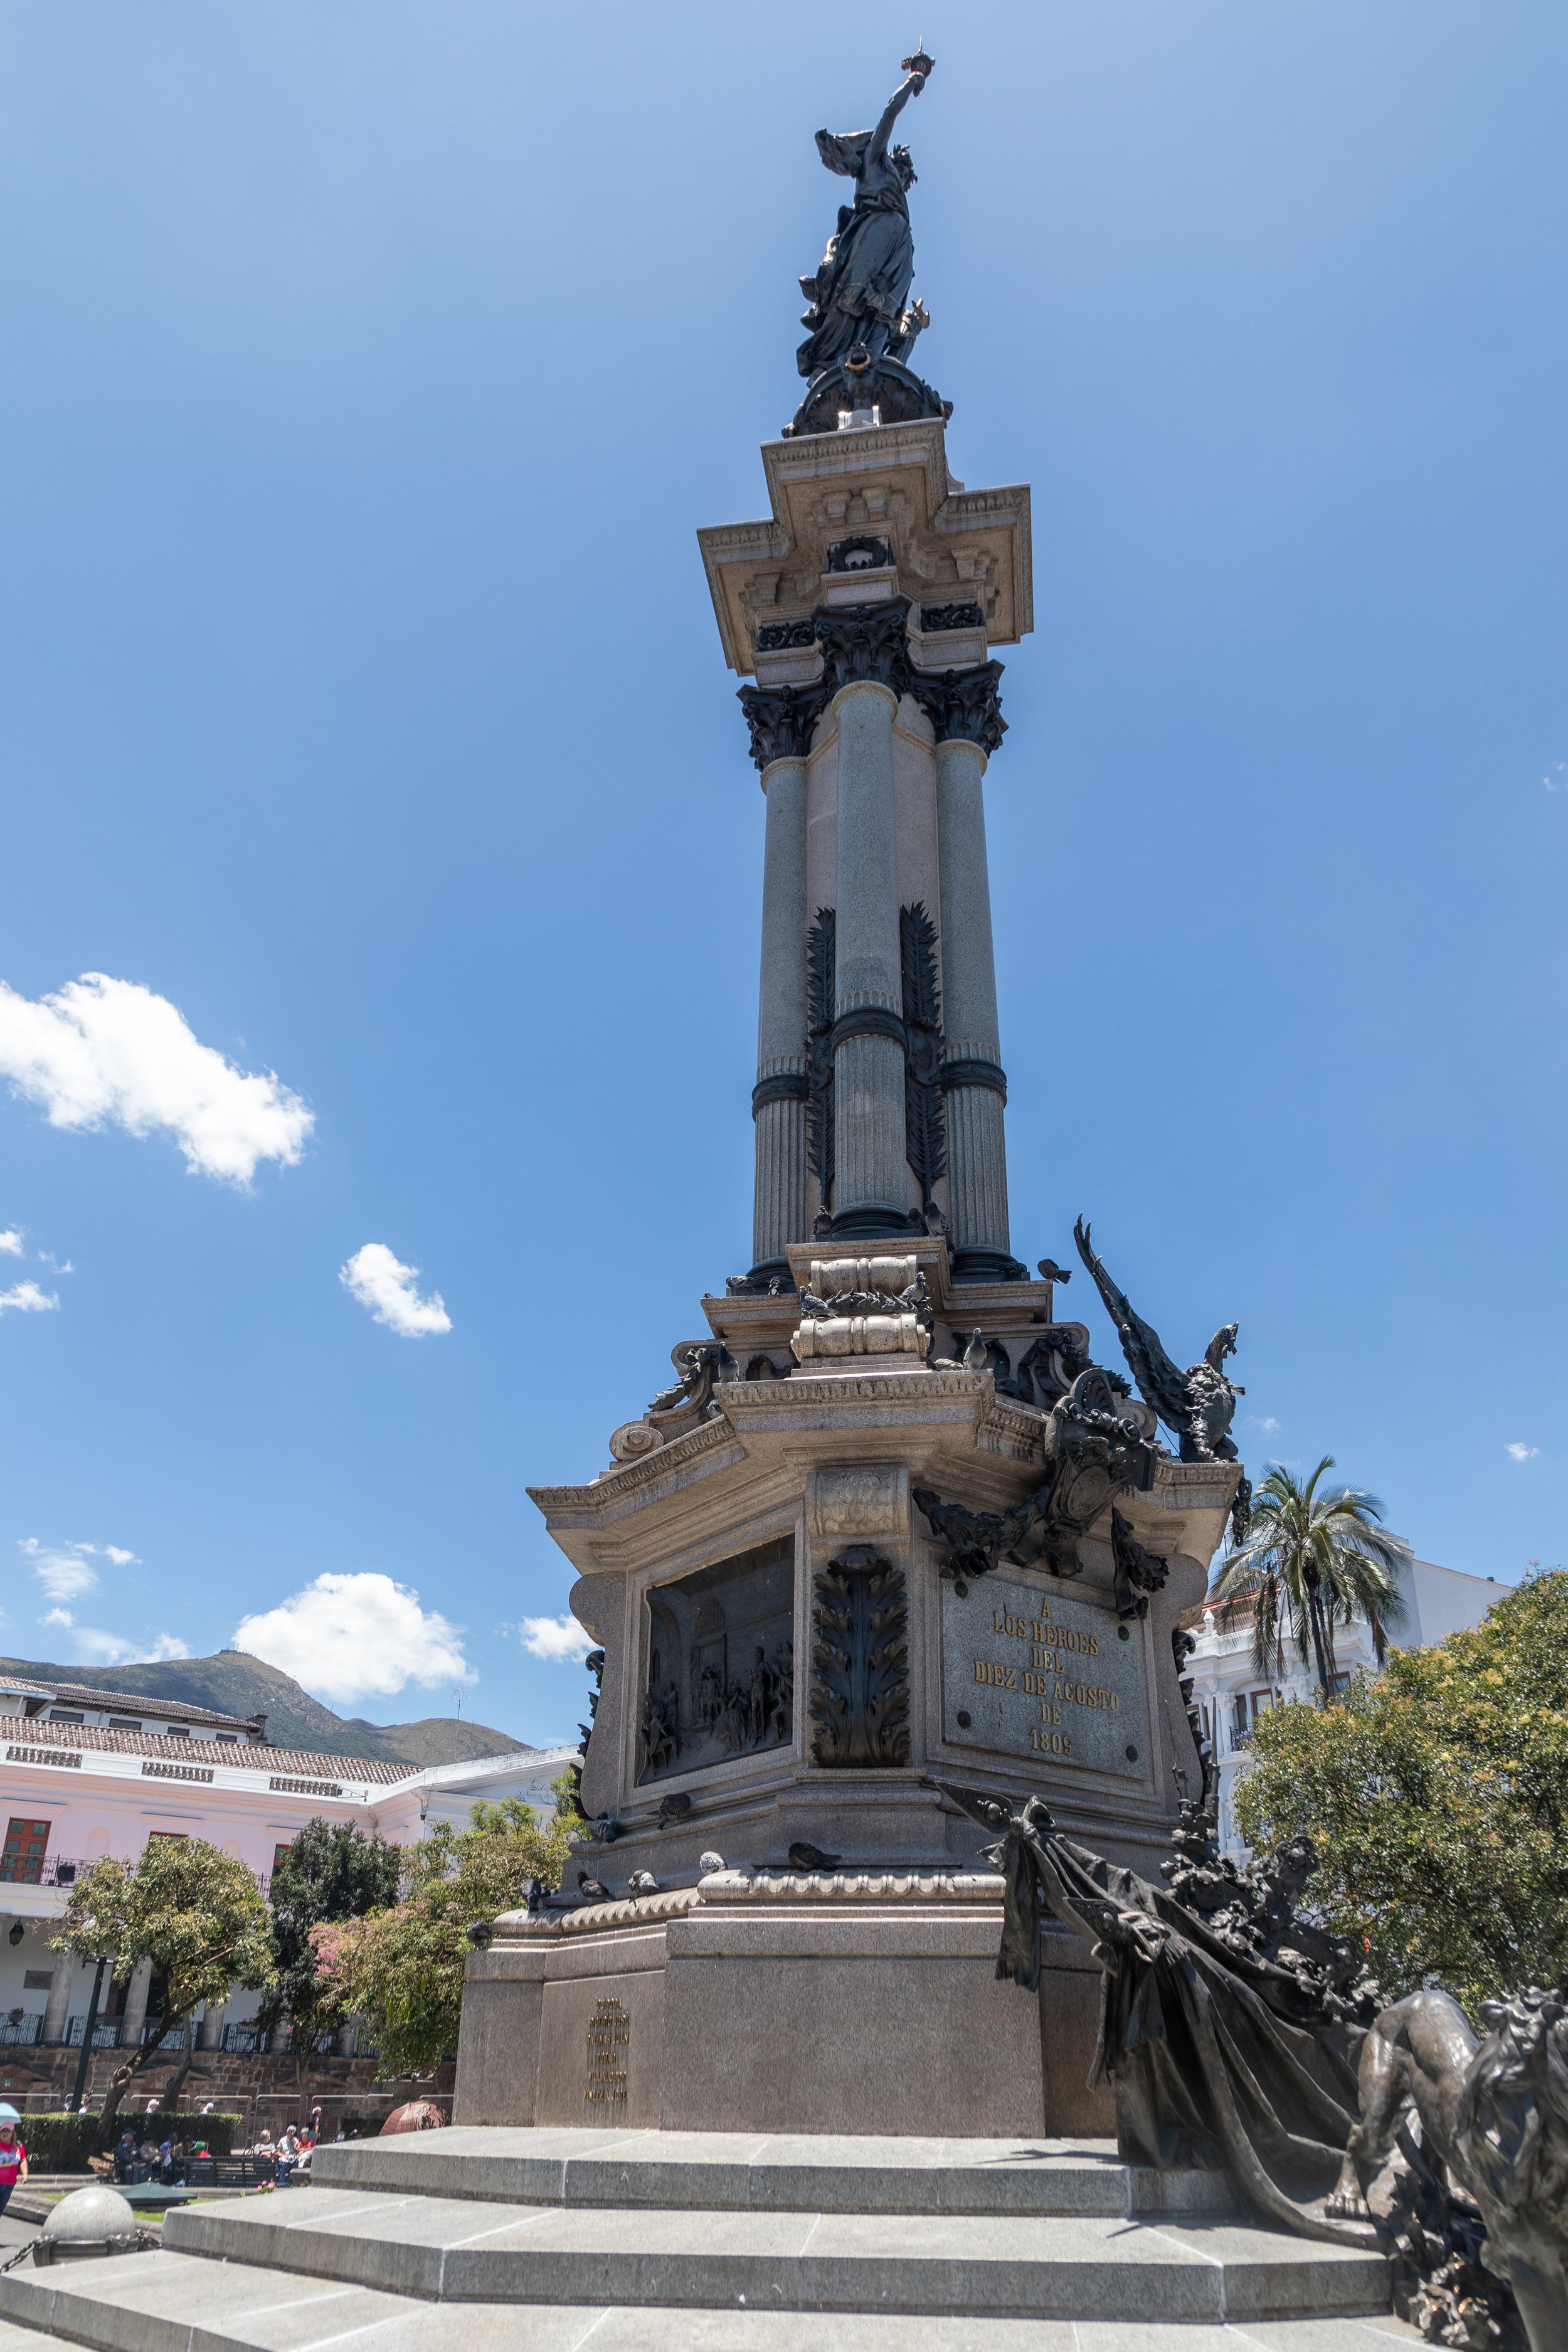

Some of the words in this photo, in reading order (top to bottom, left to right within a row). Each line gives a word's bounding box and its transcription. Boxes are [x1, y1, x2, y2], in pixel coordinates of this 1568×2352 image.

[1042, 1599, 1052, 1619] A
[993, 1611, 1027, 1638] LOS
[1032, 1621, 1099, 1656] HEROES
[1032, 1647, 1065, 1674] DEL
[974, 1661, 1018, 1690] DIEZ
[1024, 1671, 1047, 1696] DE
[1041, 1703, 1061, 1725] DE
[1030, 1729, 1073, 1756] 1809
